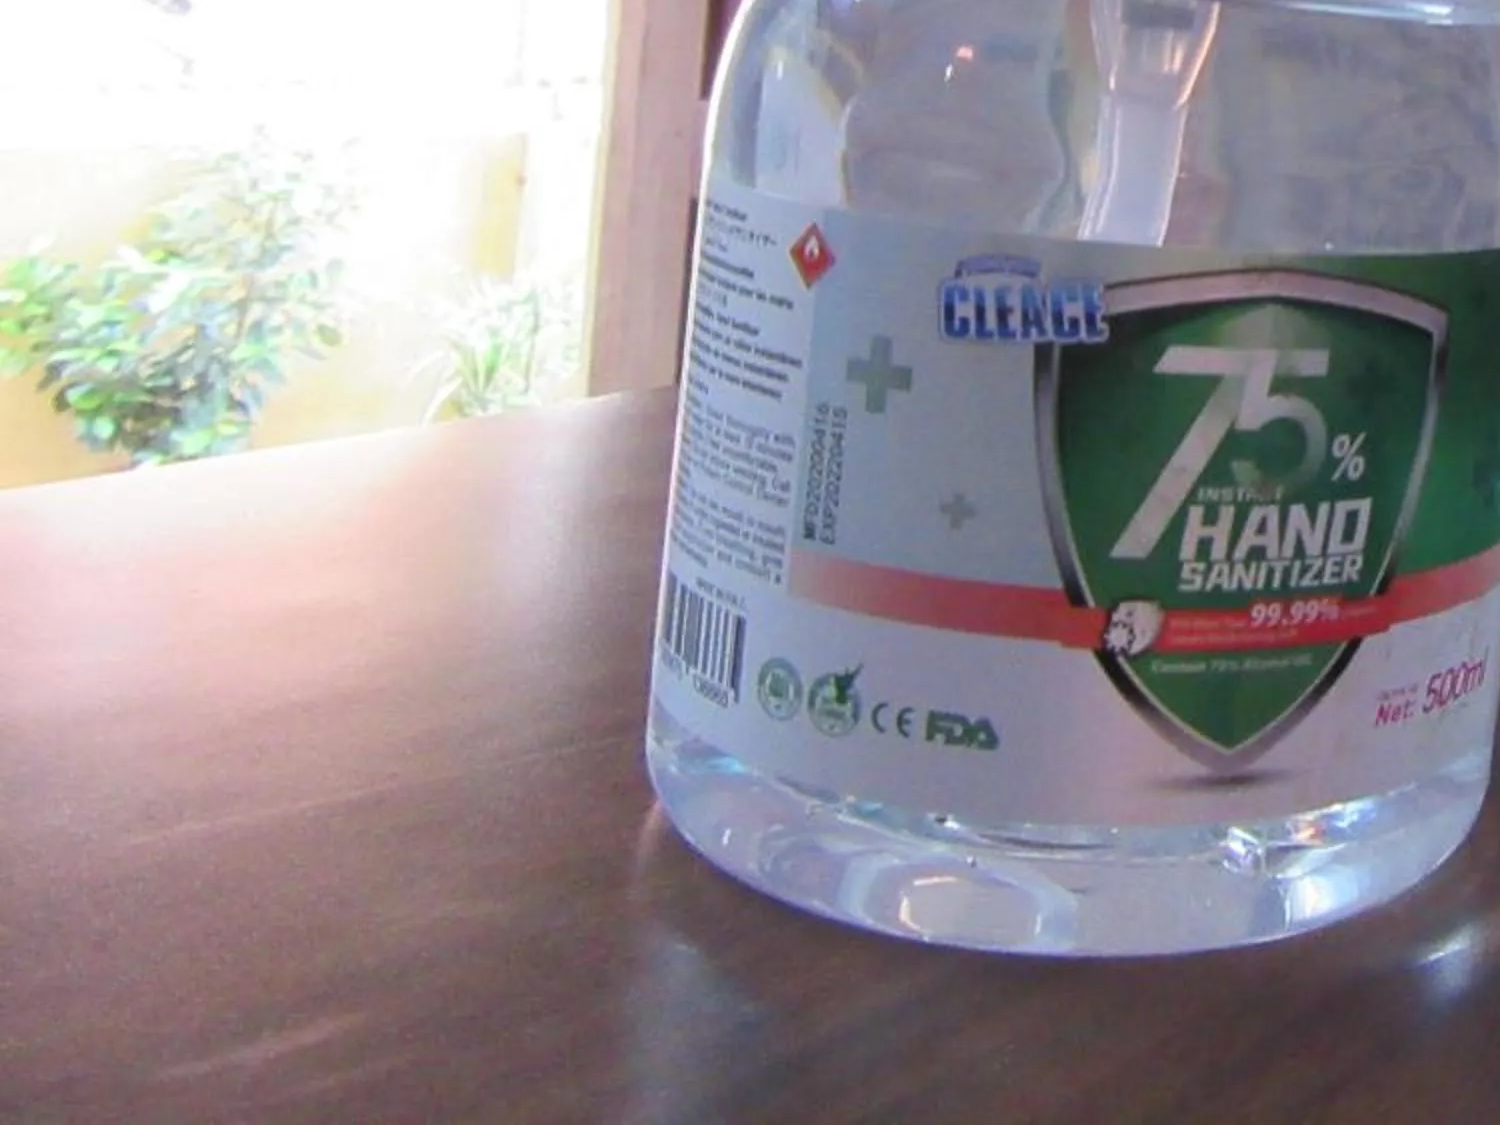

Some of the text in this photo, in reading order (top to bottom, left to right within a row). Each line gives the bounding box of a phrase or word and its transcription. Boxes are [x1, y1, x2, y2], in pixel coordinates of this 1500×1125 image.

[1179, 497, 1373, 563] HAND
[1177, 552, 1364, 594] SANITIZER
[925, 709, 999, 751] FDA
